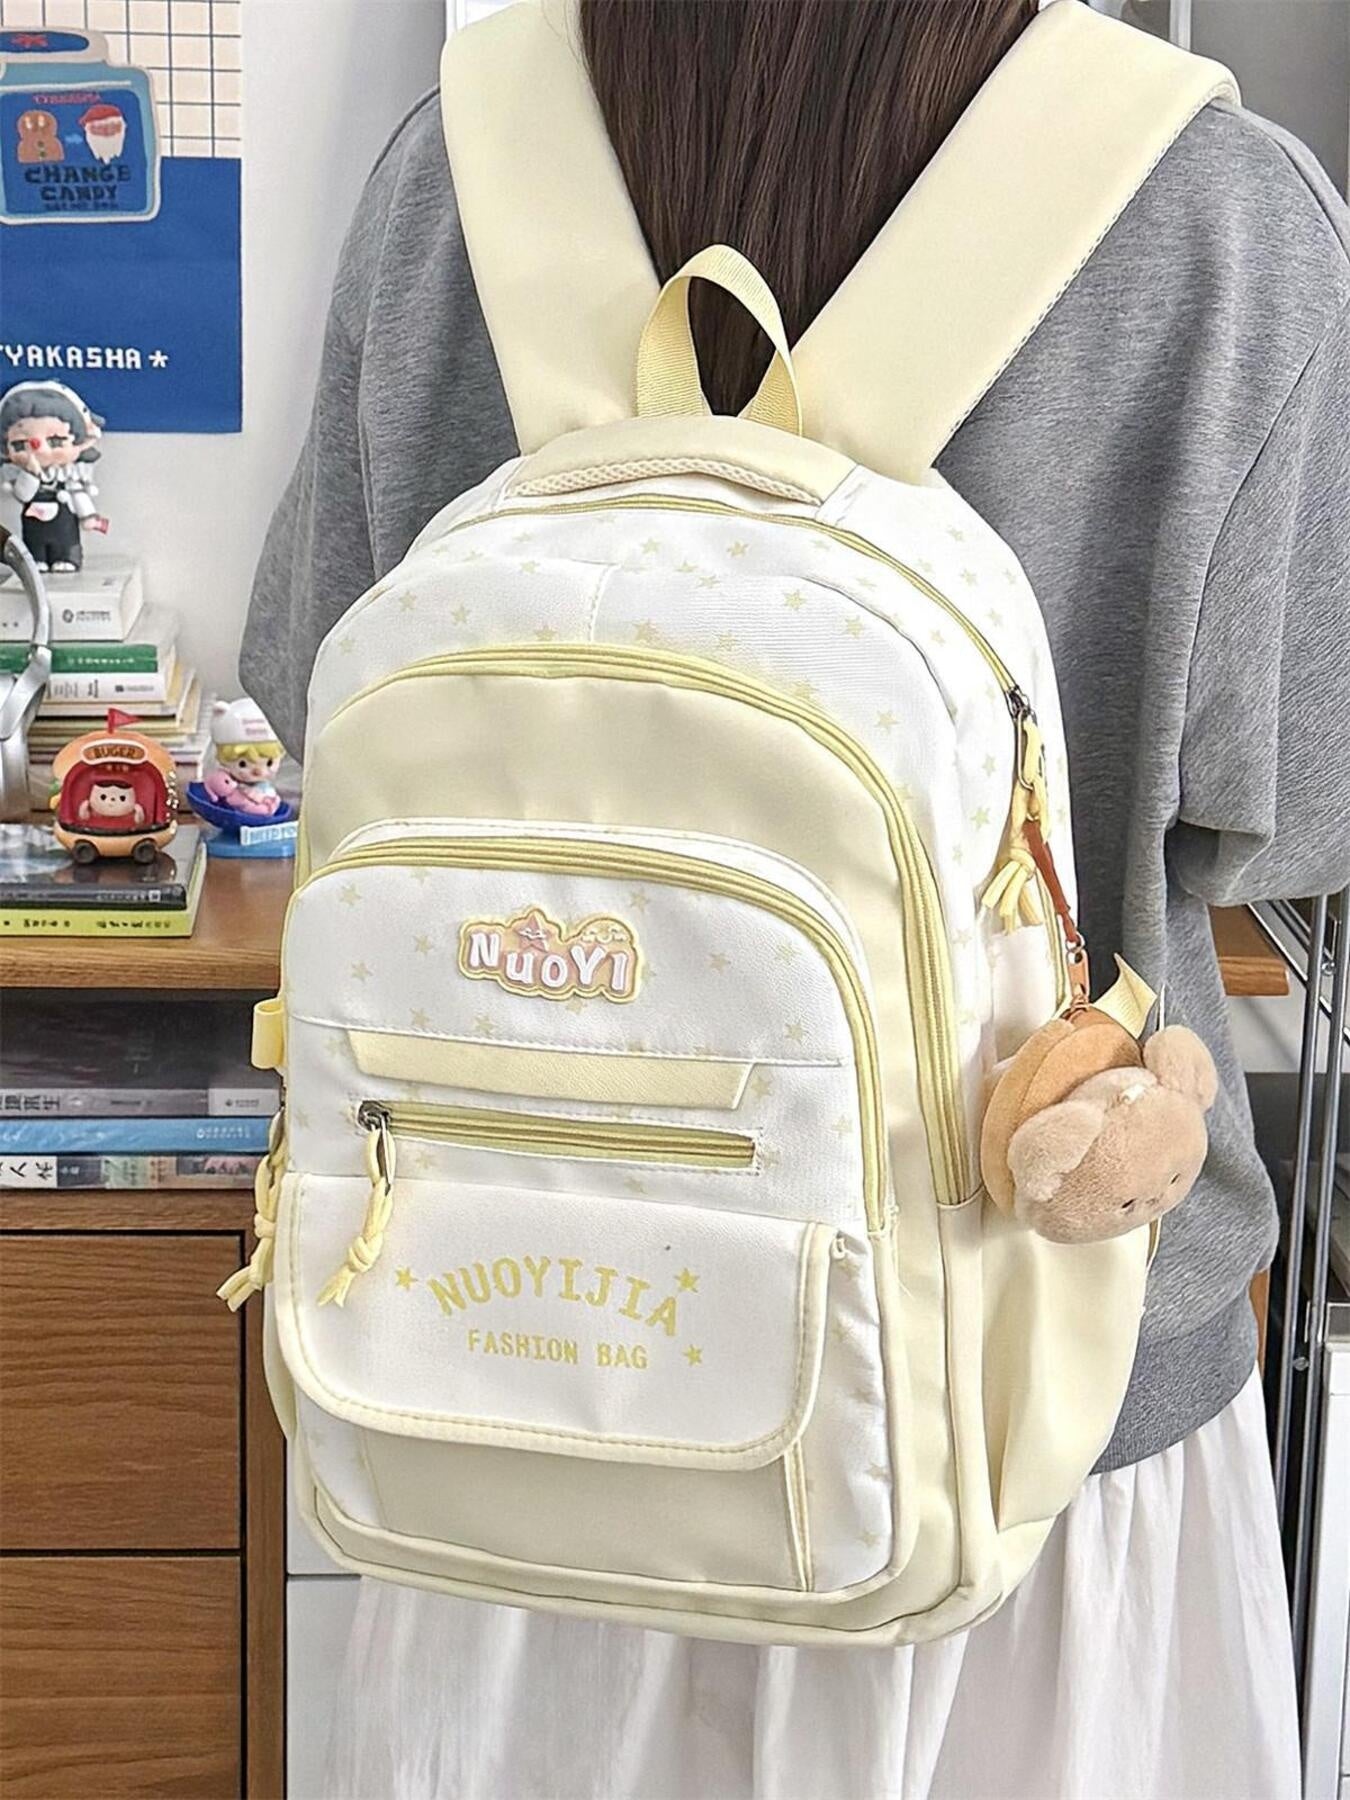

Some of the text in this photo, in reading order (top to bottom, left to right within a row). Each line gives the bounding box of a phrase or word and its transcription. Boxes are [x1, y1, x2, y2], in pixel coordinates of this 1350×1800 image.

[24, 164, 132, 184] CHANGE
[40, 185, 118, 201] CANDY
[0, 344, 142, 369] YAKASHA
[426, 1255, 679, 1337] NUOYIJIA
[467, 1328, 648, 1369] FASHION BAG
